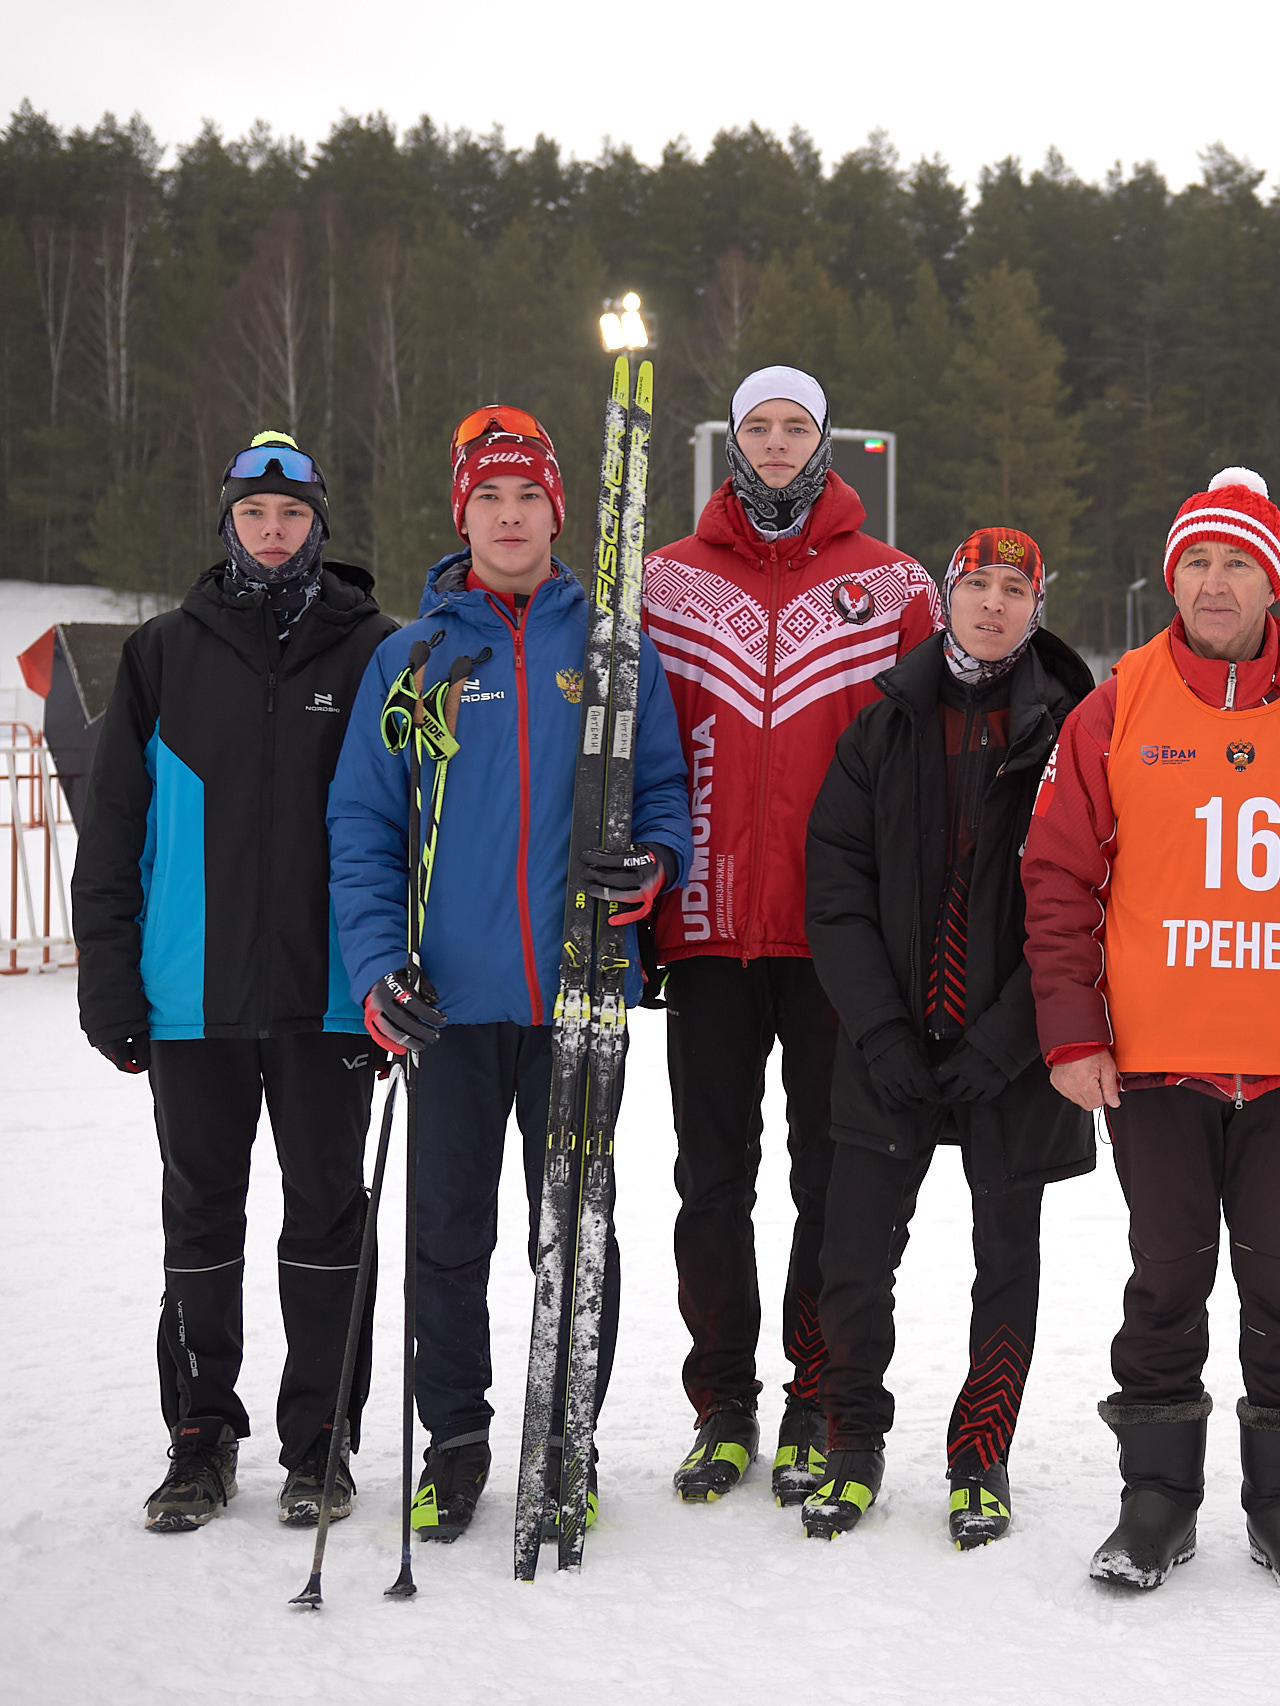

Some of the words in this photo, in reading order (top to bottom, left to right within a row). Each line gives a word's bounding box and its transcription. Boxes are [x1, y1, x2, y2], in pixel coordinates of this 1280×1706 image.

[596, 422, 626, 615] FISCHER
[460, 691, 505, 703] RDSKI
[681, 714, 716, 942] UDMURTIA
